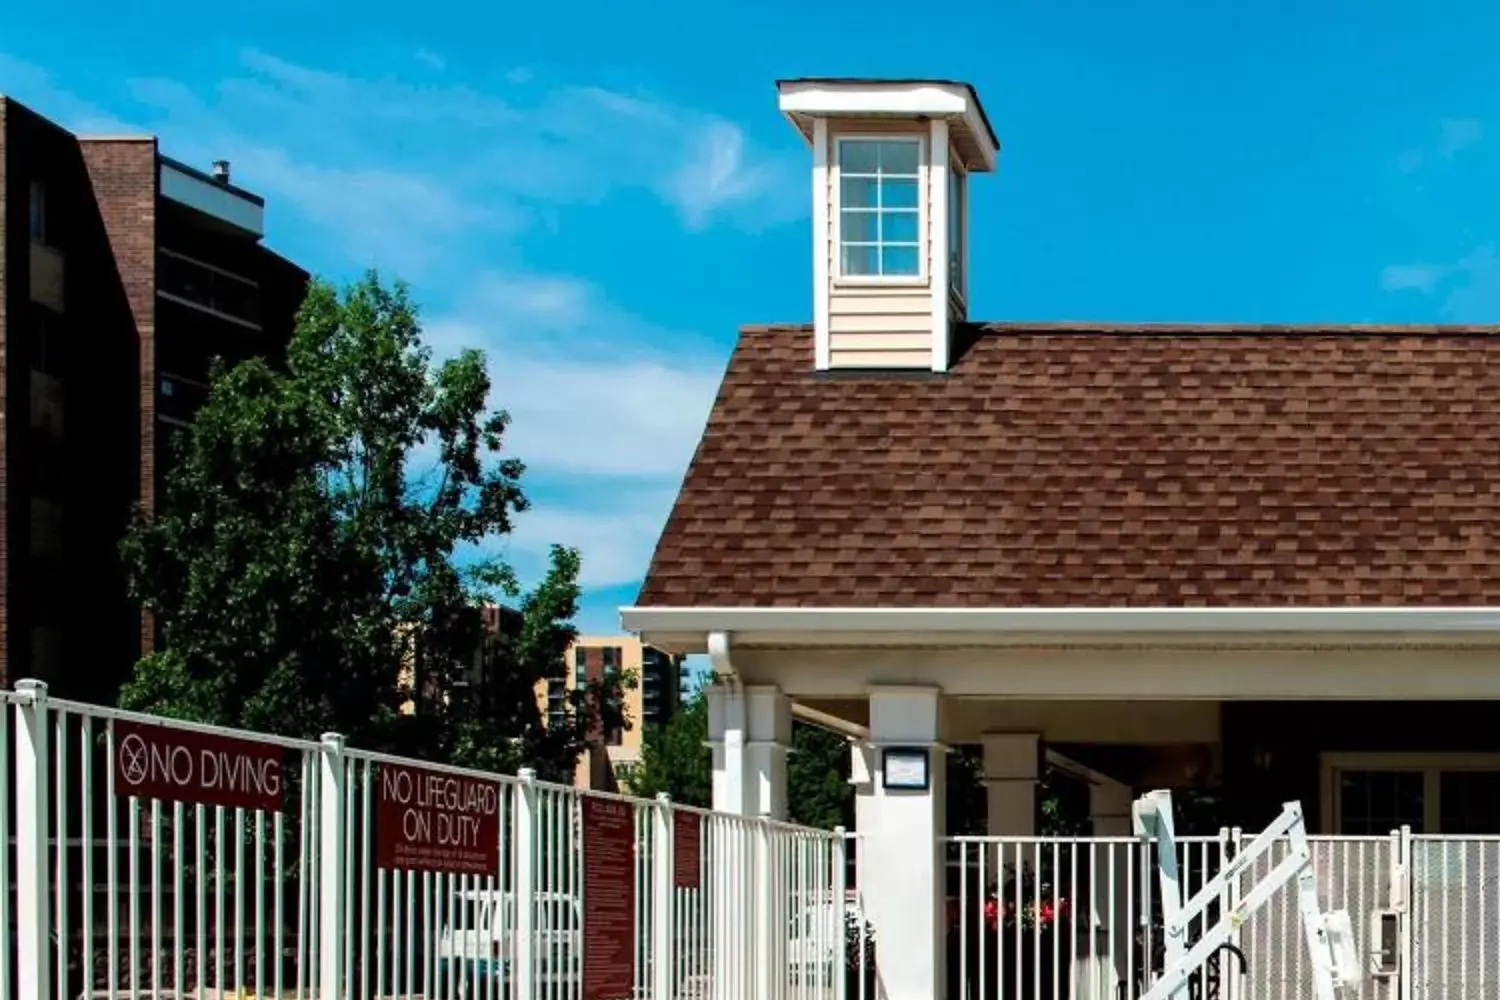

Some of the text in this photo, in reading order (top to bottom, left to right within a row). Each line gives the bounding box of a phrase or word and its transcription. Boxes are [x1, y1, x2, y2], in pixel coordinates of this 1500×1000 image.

[151, 741, 280, 796] NO DIVING
[382, 767, 497, 815] NO LIFEGUARD
[403, 807, 481, 847] ON DUTY
